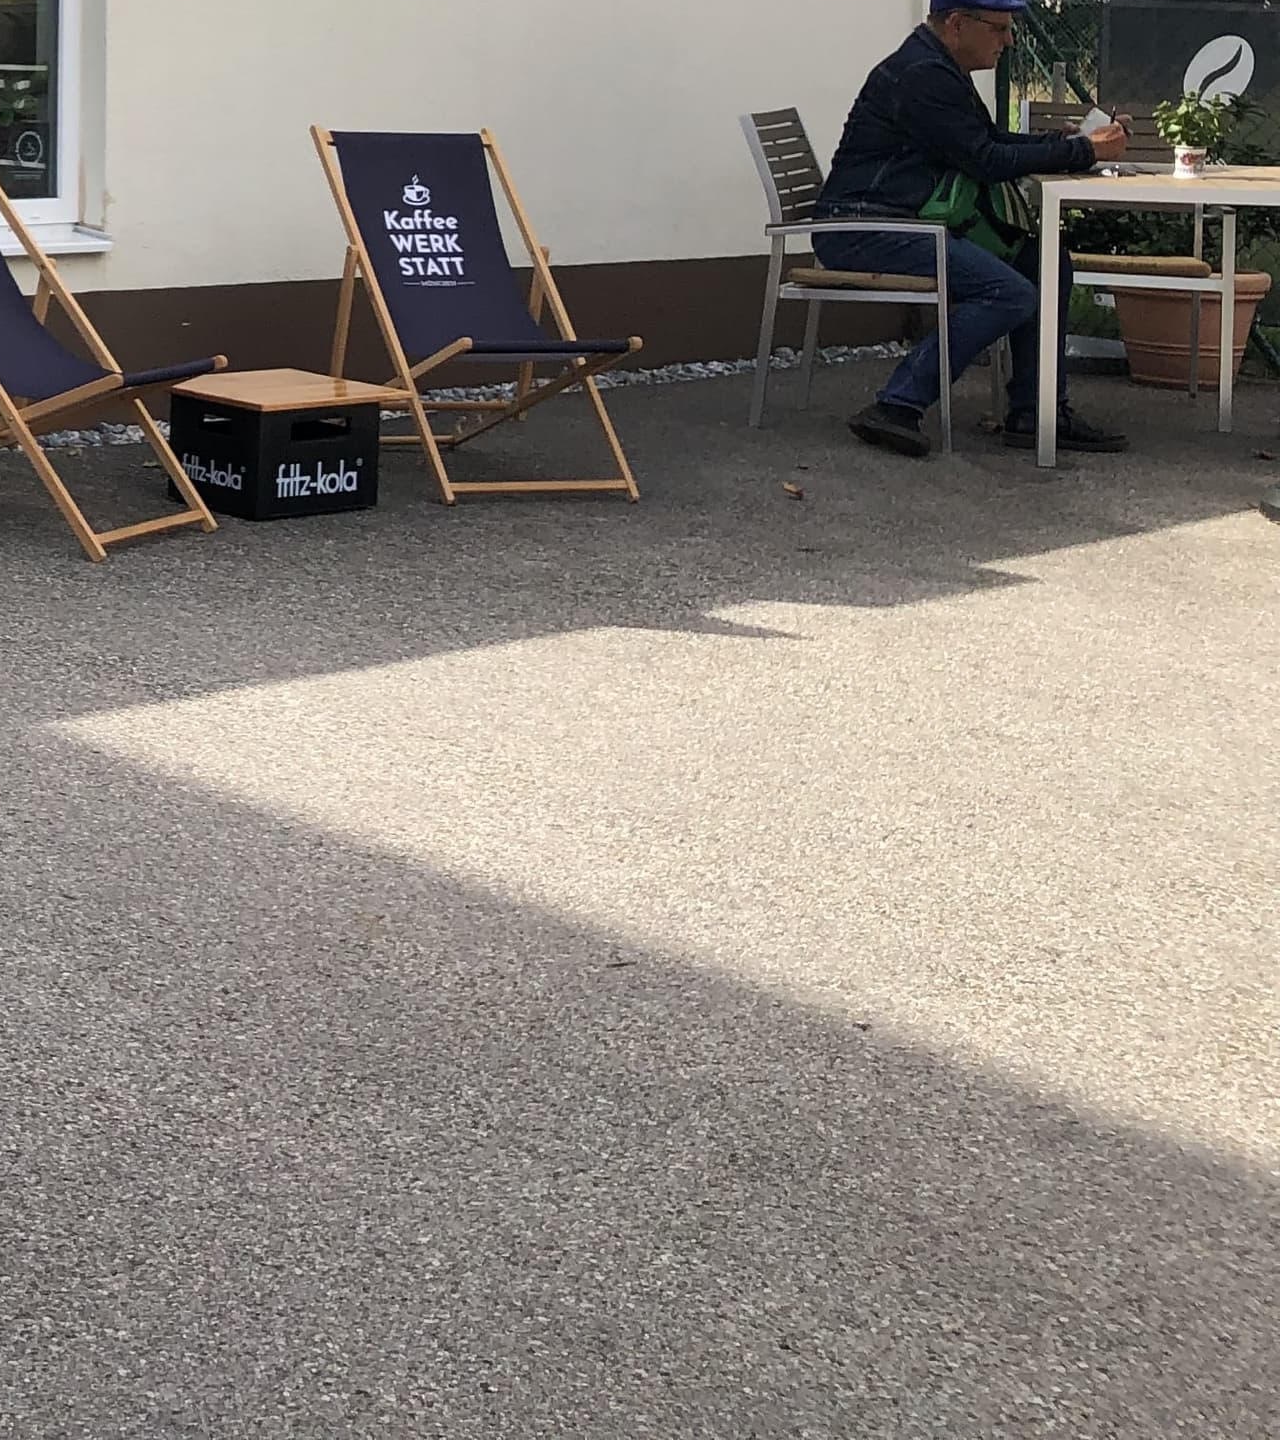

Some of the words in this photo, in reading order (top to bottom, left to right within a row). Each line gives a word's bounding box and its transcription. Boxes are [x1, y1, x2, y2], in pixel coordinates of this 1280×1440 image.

[383, 209, 458, 230] Kaffee
[389, 233, 464, 253] WERK
[398, 256, 465, 276] STATT
[276, 459, 359, 499] fritz-kola
